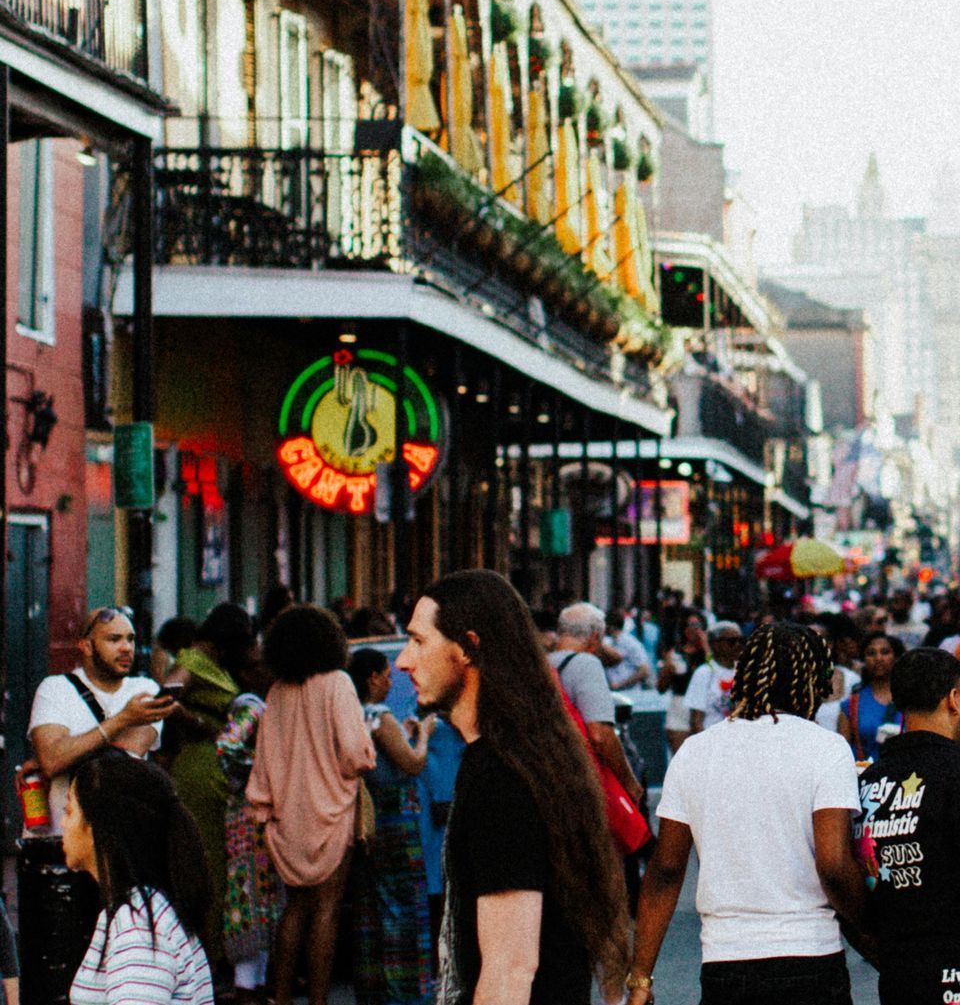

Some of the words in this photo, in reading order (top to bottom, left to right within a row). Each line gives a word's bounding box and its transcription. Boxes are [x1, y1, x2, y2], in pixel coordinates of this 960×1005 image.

[278, 436, 439, 513] CANTA
[860, 776, 896, 804] ively
[889, 785, 926, 811] And
[880, 841, 924, 867] SUN
[891, 866, 922, 889] NY
